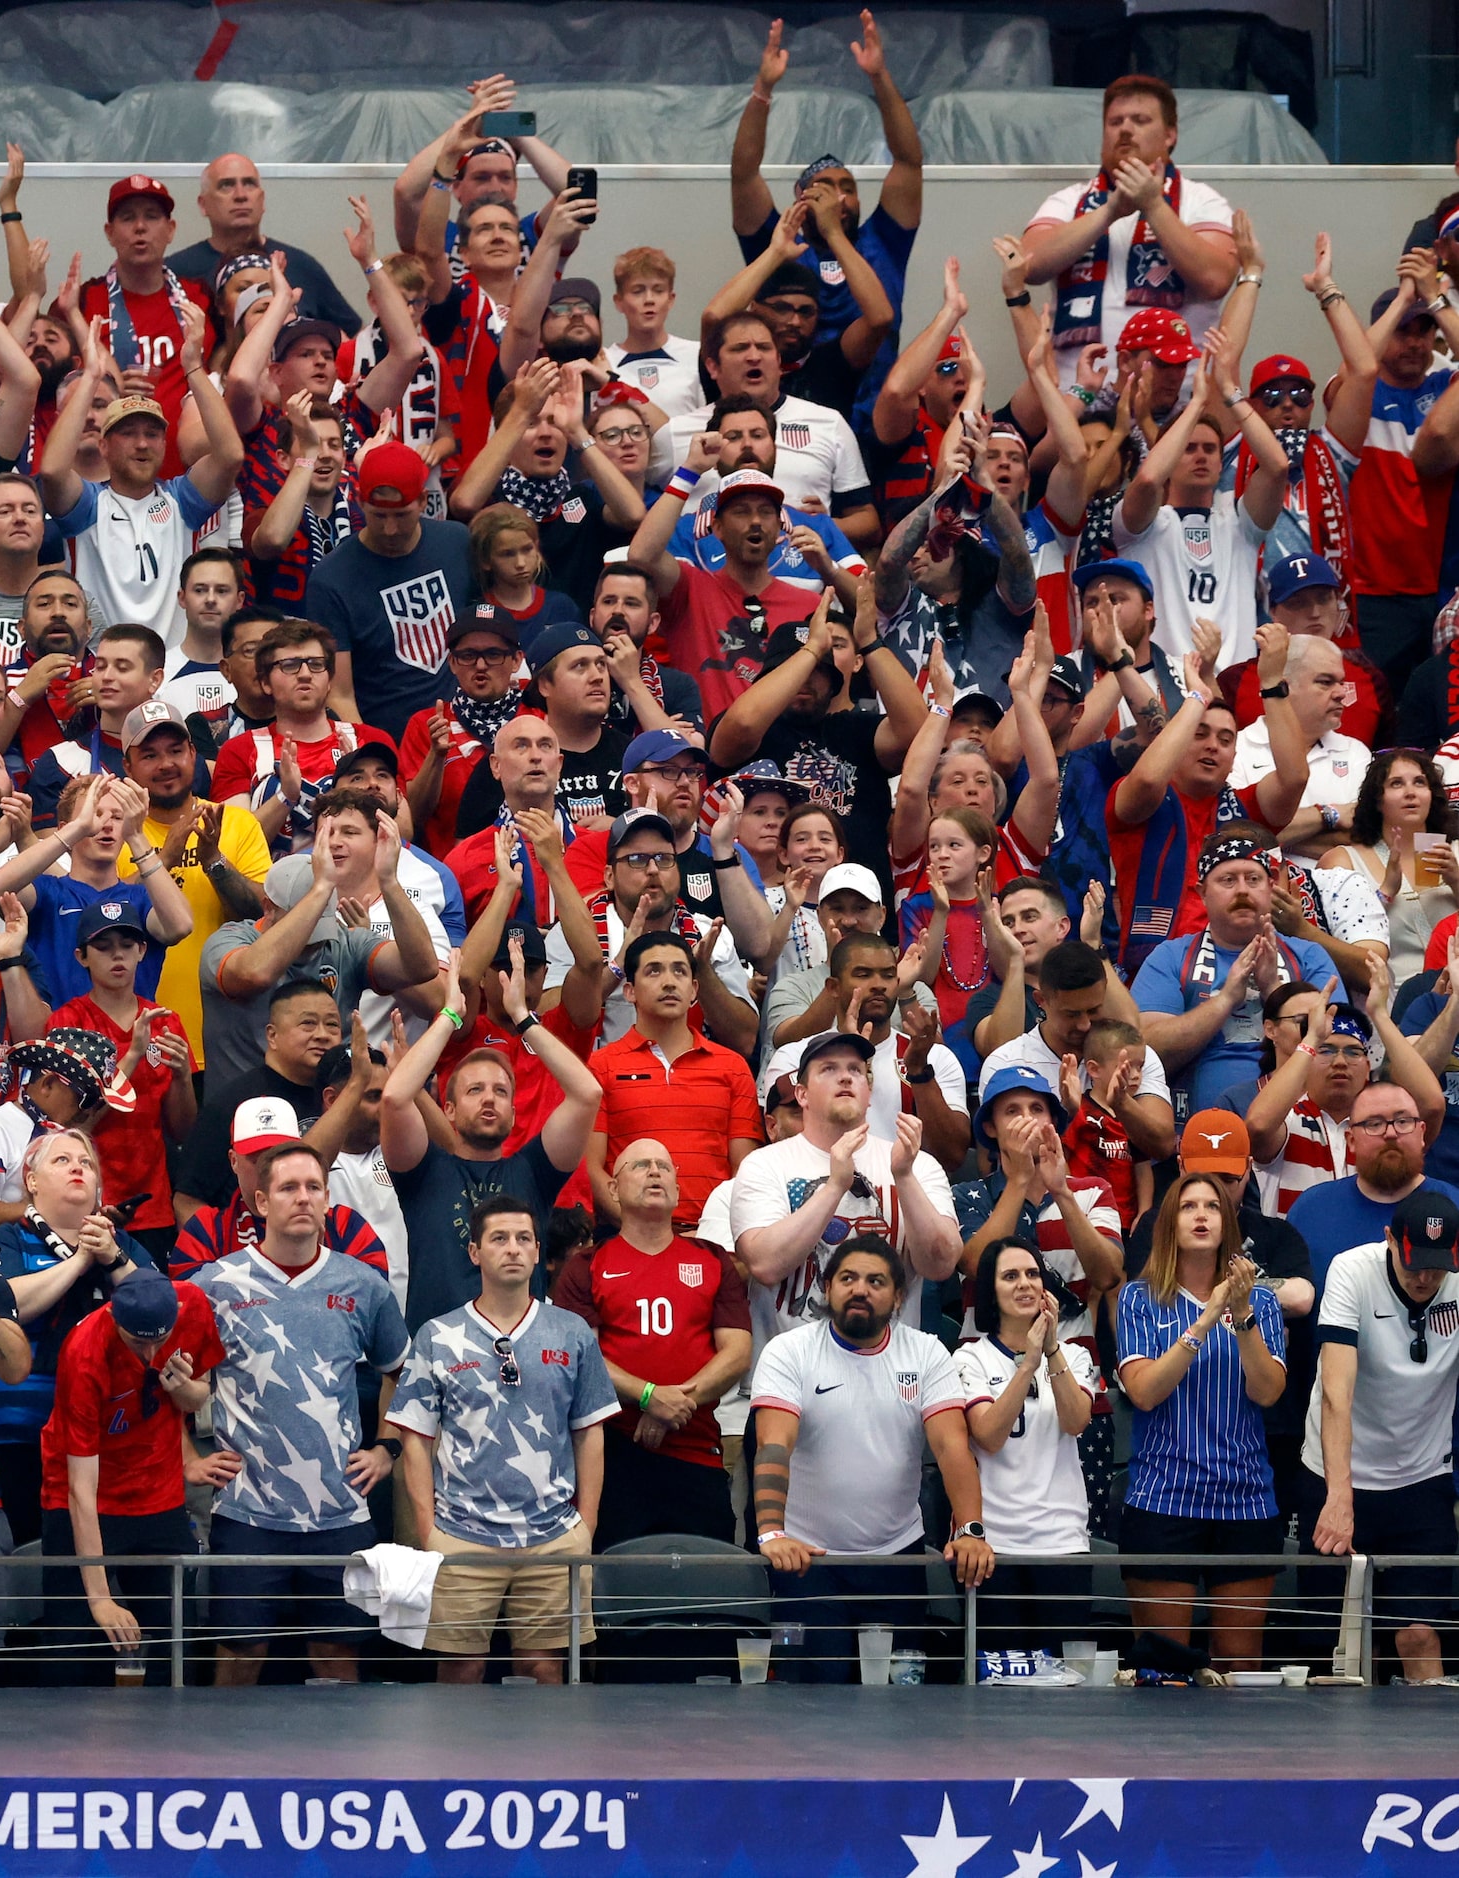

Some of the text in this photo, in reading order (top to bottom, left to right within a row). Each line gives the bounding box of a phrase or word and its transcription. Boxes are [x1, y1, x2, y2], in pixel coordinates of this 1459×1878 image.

[139, 336, 174, 374] 10
[409, 358, 436, 441] EVE
[148, 500, 167, 514] USA
[425, 492, 443, 518] SA
[562, 500, 581, 512] USA
[1187, 530, 1208, 541] USA
[1289, 557, 1309, 578] T
[1188, 568, 1217, 604] 10
[386, 575, 447, 621] USA
[197, 686, 221, 699] USA
[662, 727, 682, 740] T
[688, 875, 709, 886] USA
[146, 1045, 158, 1055] US
[1099, 1137, 1127, 1151] Emir
[372, 1161, 386, 1172] US
[1428, 1217, 1443, 1228] USA
[680, 1264, 701, 1275] USA
[232, 1298, 268, 1311] adidas
[636, 1297, 673, 1336] 10
[447, 1361, 481, 1374] adidas
[898, 1374, 918, 1386] USA
[281, 1790, 426, 1853] USA
[444, 1790, 625, 1850] 2024
